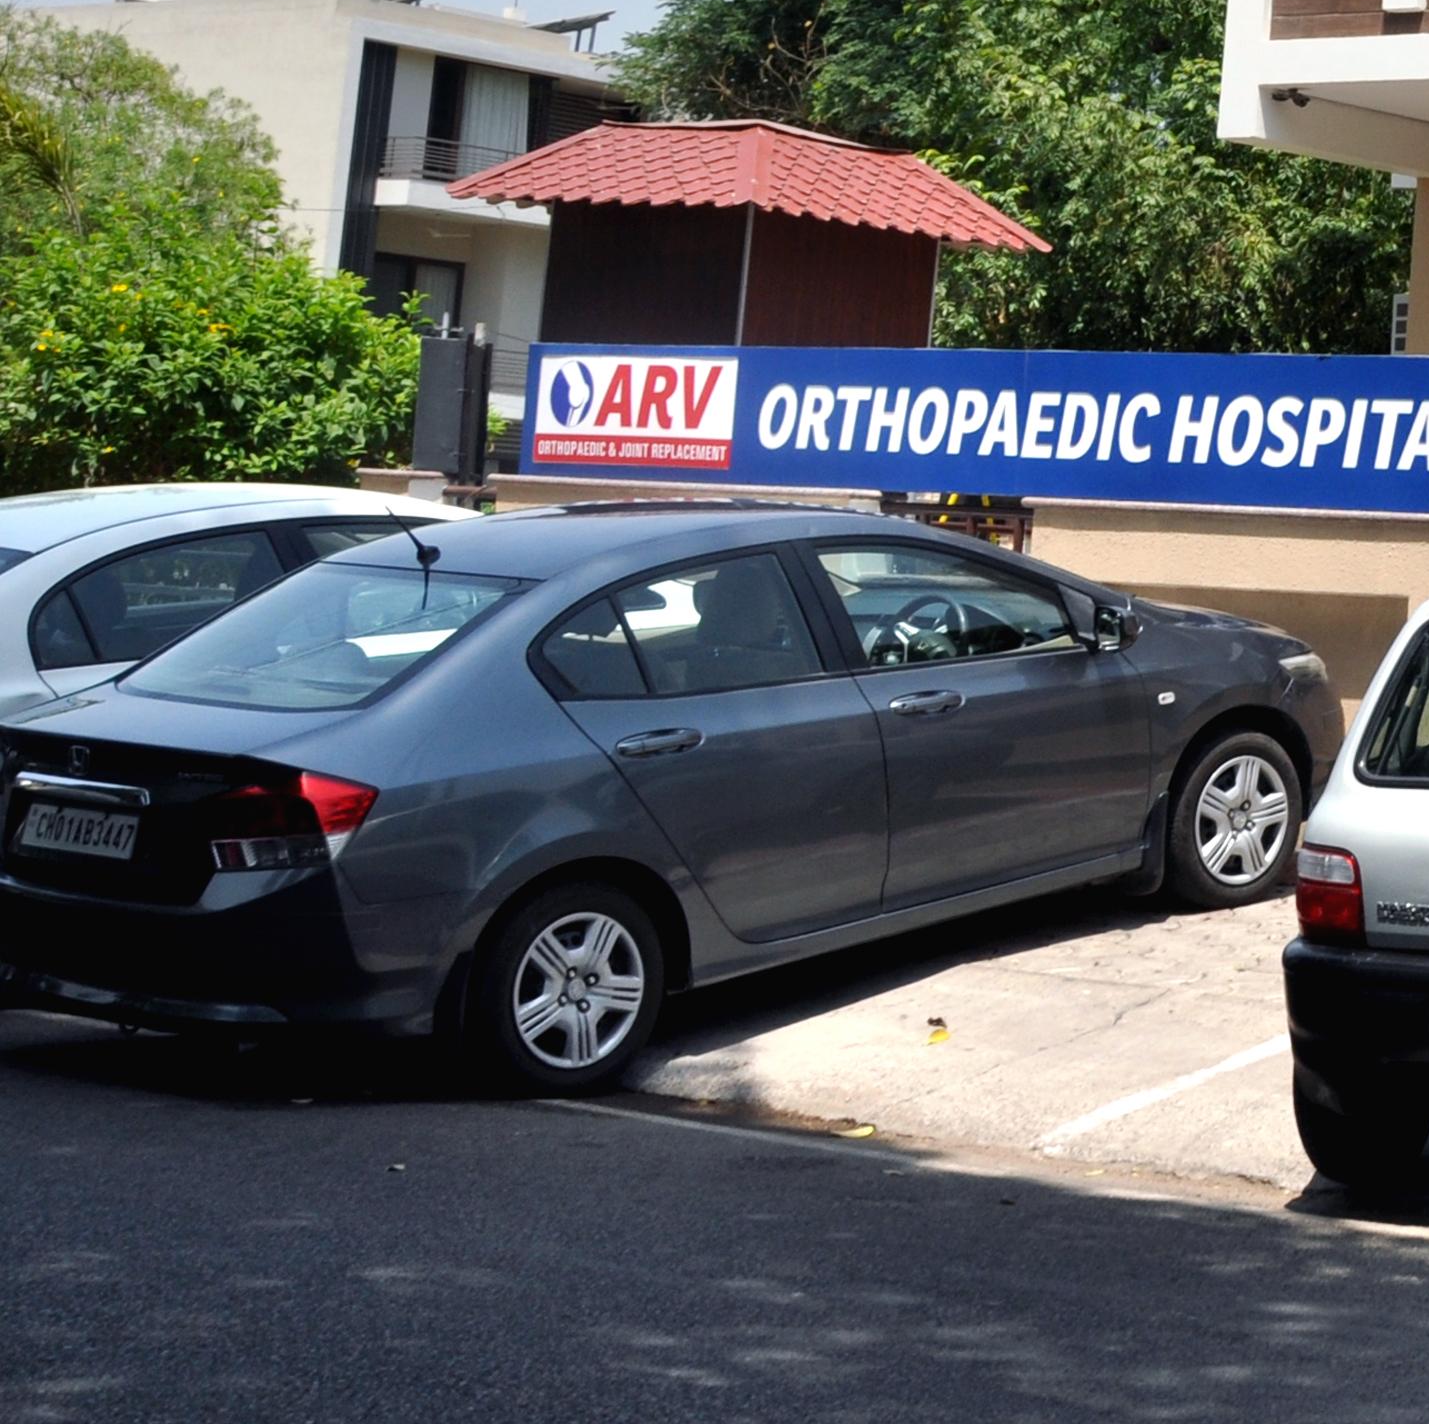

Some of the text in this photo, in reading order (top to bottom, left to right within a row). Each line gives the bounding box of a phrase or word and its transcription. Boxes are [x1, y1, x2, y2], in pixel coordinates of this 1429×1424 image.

[594, 364, 723, 430] ARV
[758, 383, 1161, 464] ORTHOPAEDIC
[538, 439, 728, 462] ORTHOPAEDIC & JOINT REPLACEMENT
